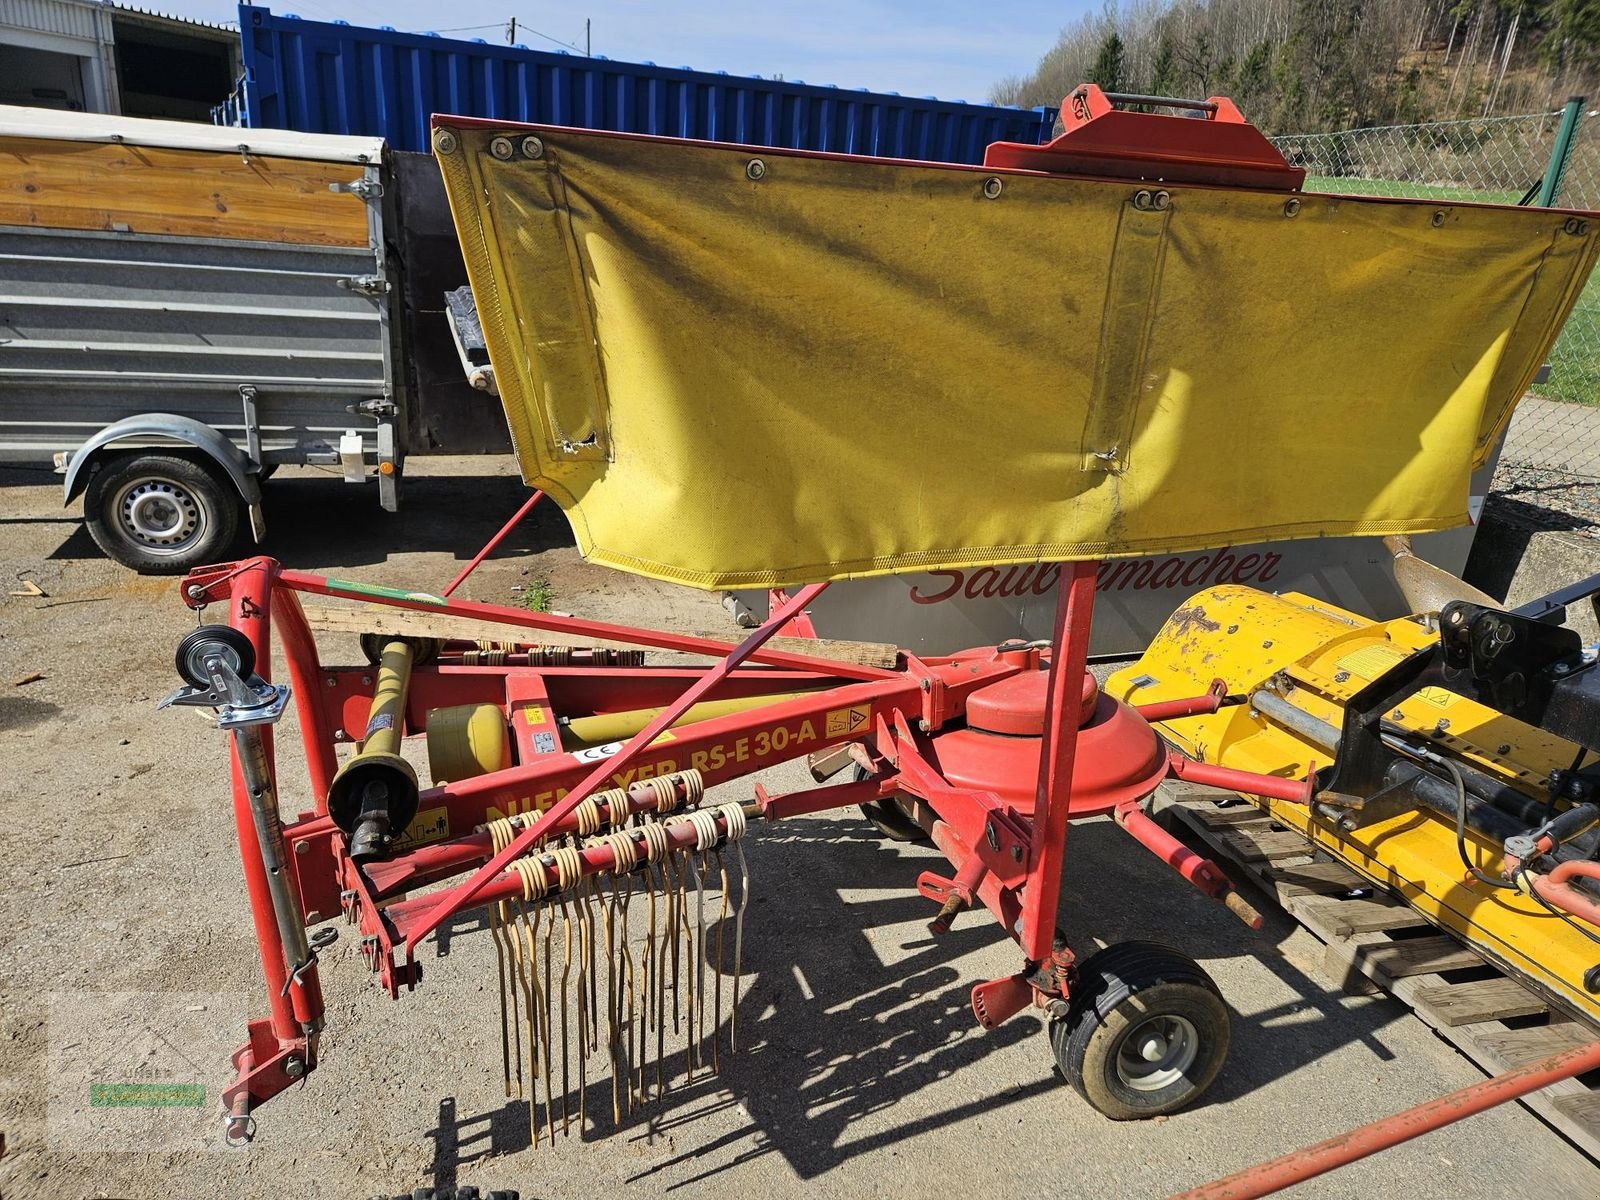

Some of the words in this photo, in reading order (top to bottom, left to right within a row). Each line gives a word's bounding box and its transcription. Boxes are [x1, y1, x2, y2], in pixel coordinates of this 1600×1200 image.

[910, 546, 1282, 604] Saubrmacher
[584, 745, 616, 760] CE
[690, 737, 749, 773] RS-E
[754, 719, 817, 757] 30-A
